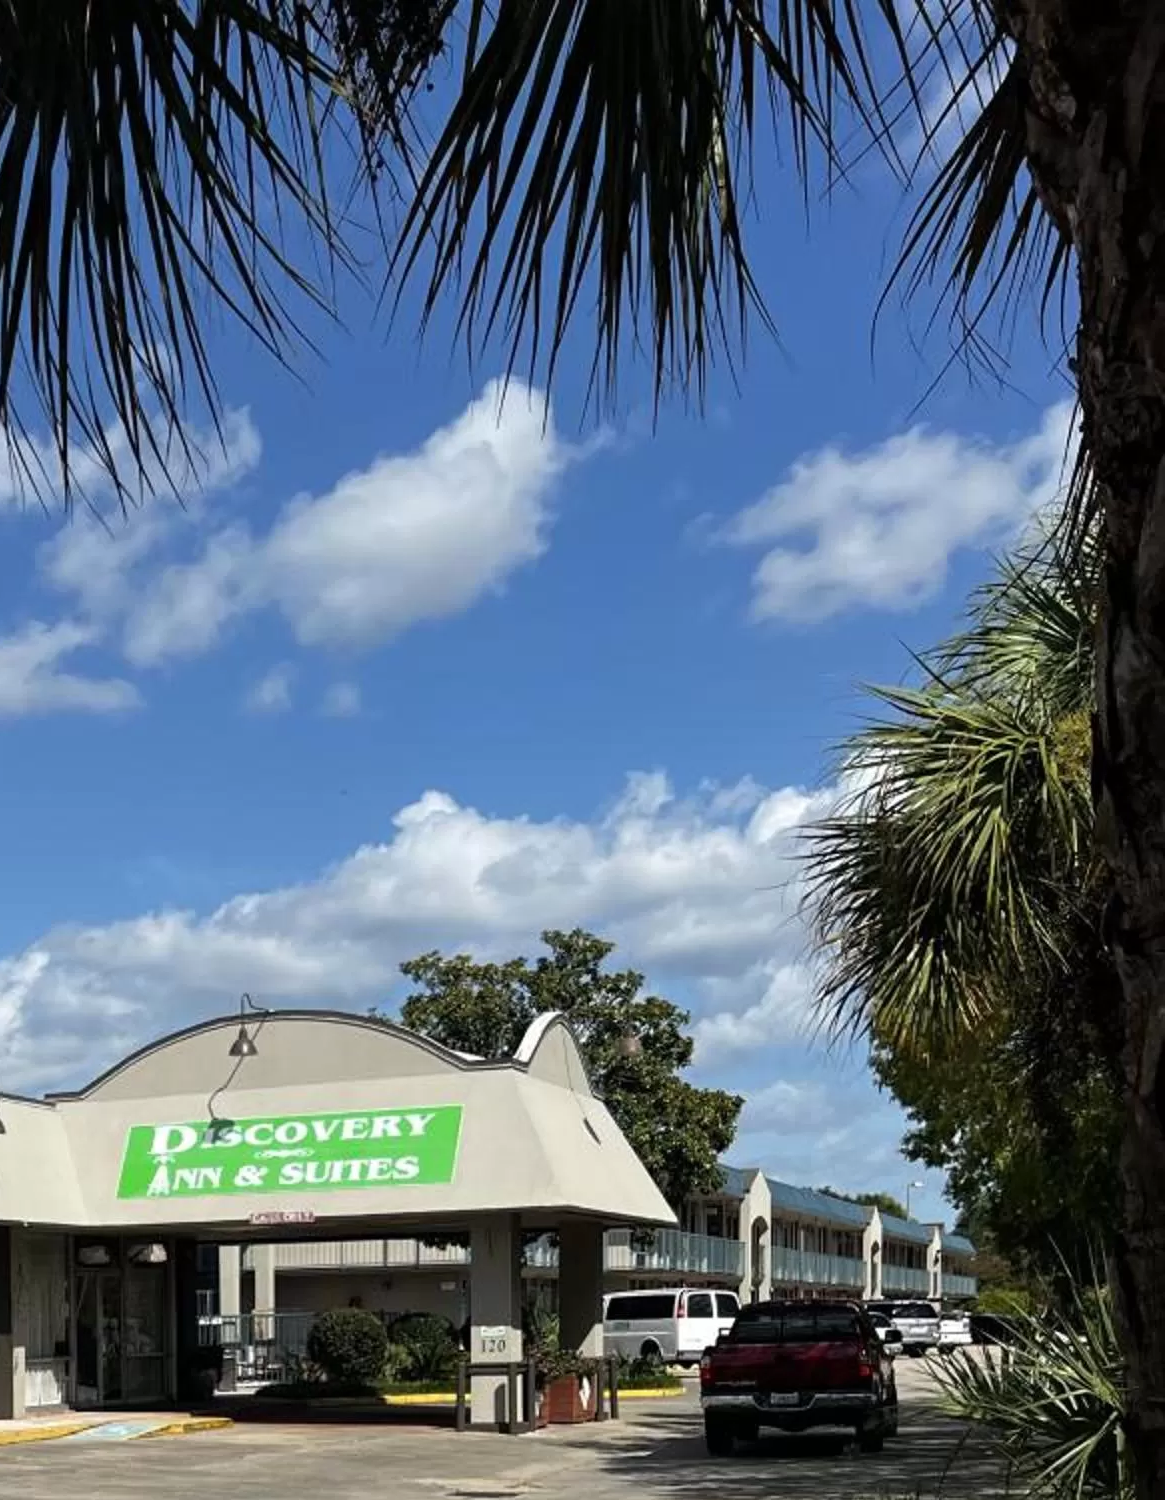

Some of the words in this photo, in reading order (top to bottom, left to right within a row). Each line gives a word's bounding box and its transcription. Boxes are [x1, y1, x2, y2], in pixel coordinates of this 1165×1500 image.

[146, 1112, 434, 1154] DISCOVERY
[234, 1165, 269, 1188] &
[278, 1156, 420, 1186] SUITES
[481, 1339, 506, 1353] 120
